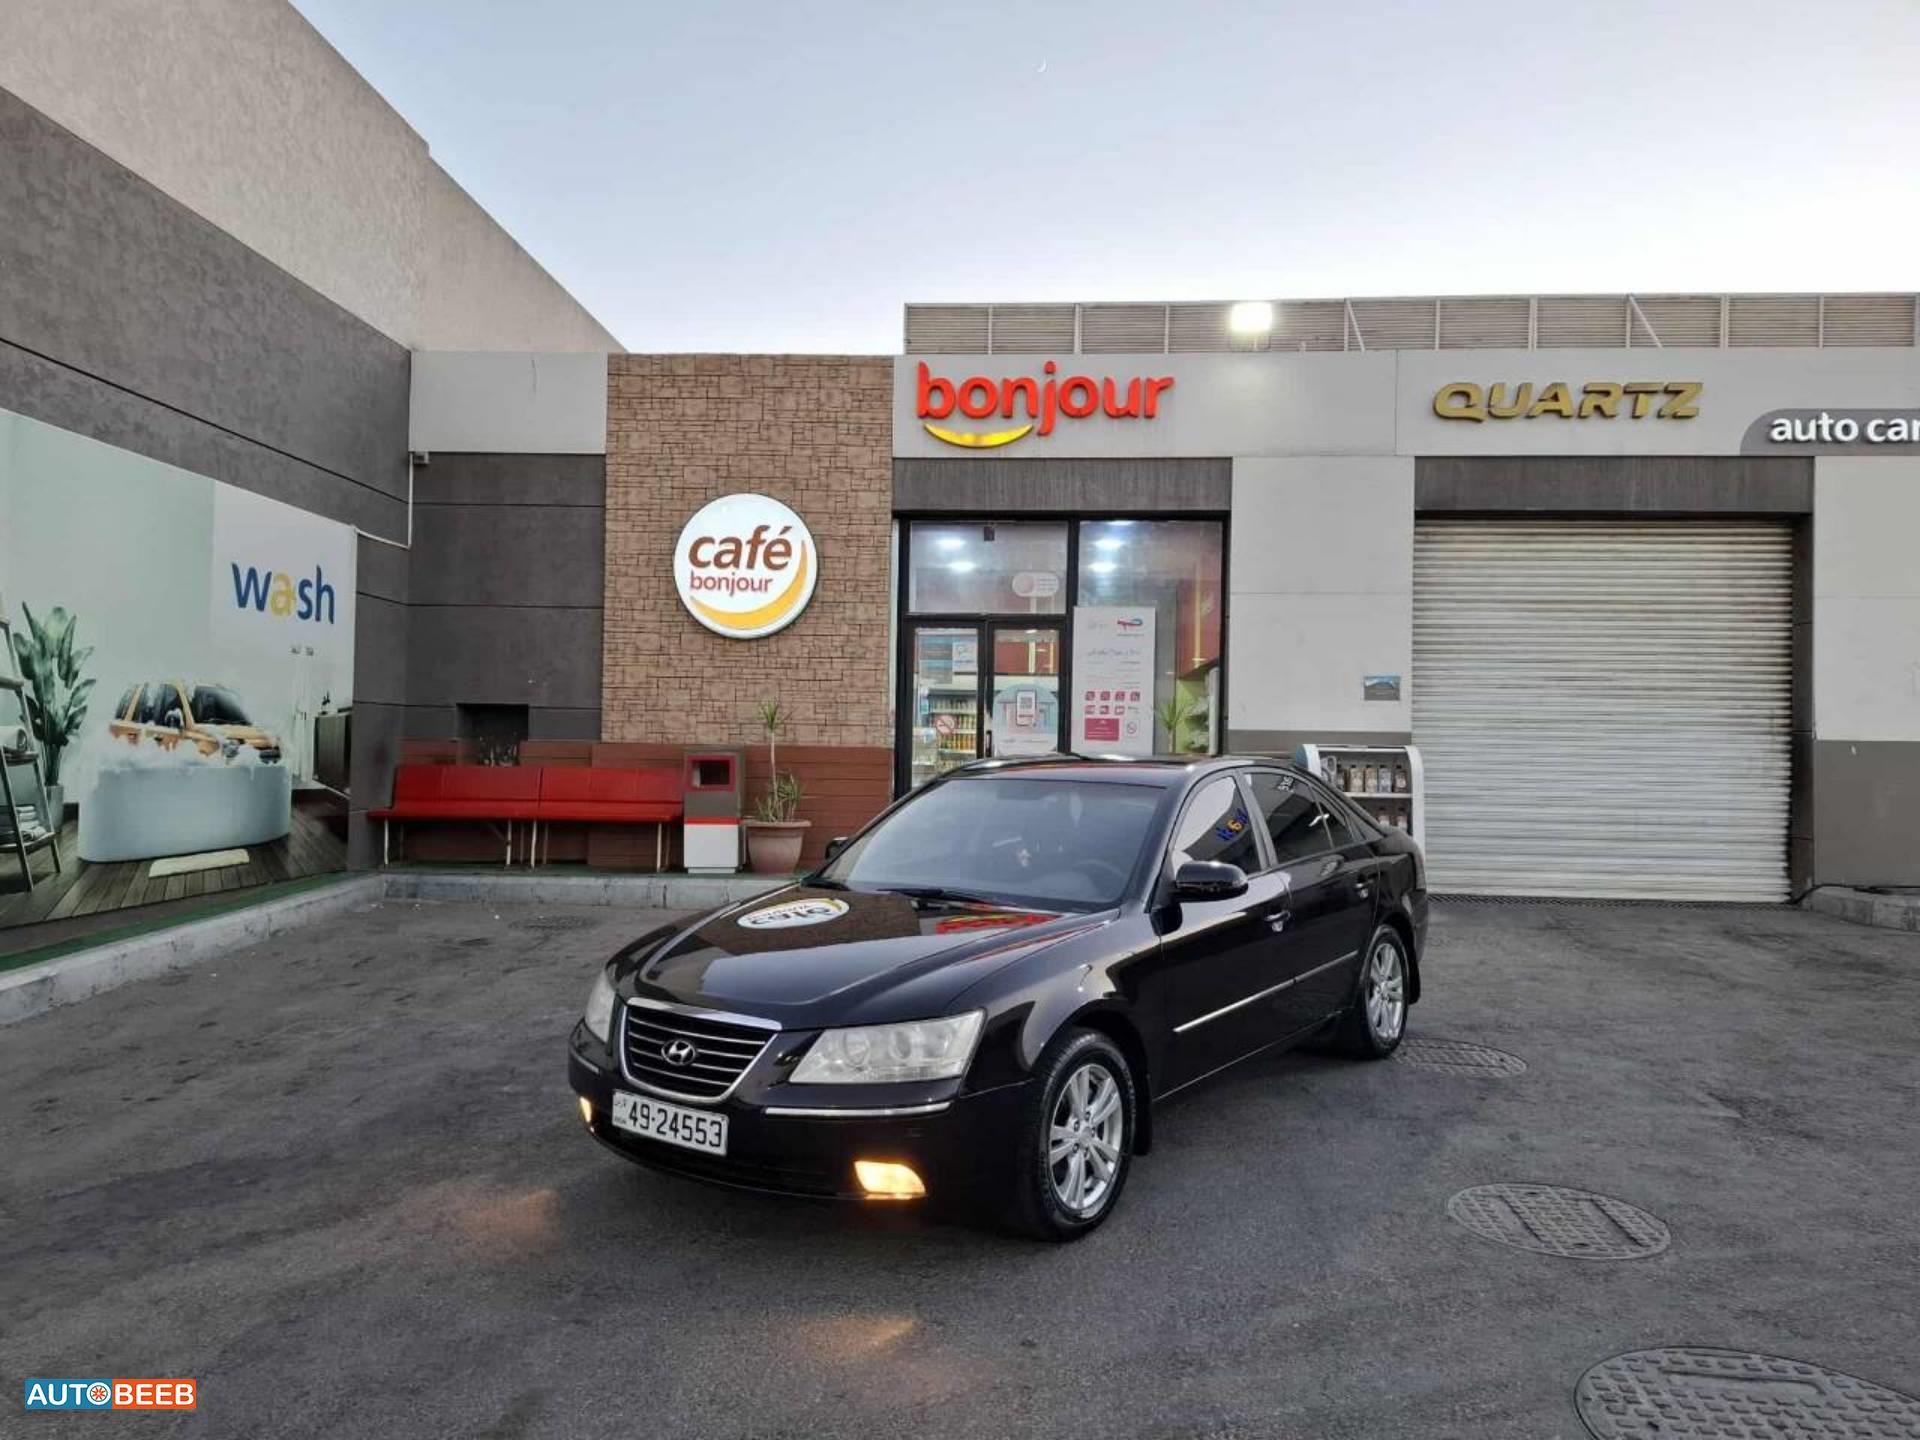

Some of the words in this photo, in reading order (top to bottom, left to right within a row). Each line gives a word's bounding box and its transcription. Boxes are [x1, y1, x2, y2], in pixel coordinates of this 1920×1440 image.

[917, 360, 1174, 436] bonjour
[1432, 381, 1704, 423] QUARTZ
[1770, 411, 1860, 442] auto
[688, 524, 793, 571] café
[231, 561, 335, 625] wash
[689, 570, 774, 597] bonjour
